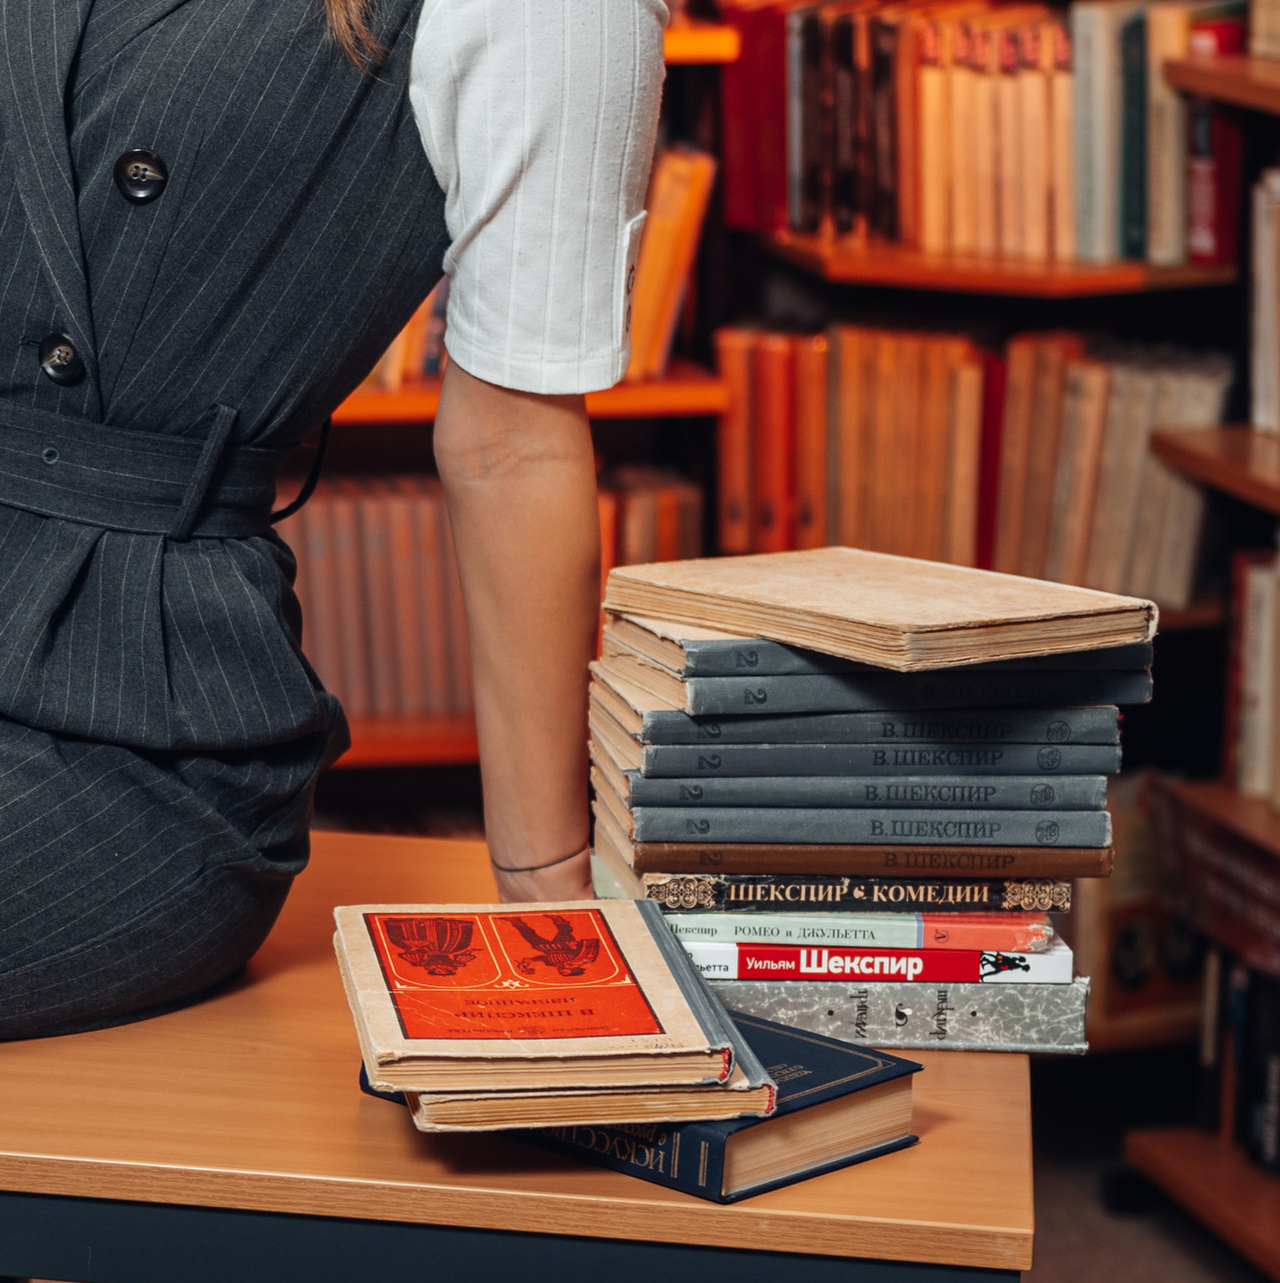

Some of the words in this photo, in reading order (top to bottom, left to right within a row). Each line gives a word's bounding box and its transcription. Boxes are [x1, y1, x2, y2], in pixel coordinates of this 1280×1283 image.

[744, 687, 768, 705] 2
[698, 754, 722, 770] 2
[680, 785, 704, 800] 2
[686, 819, 710, 835] 2
[730, 884, 849, 902] ШЕКСПИР
[873, 885, 989, 905] КОМЕДИИ
[734, 925, 780, 937] РОМЕО
[785, 929, 793, 938] и
[797, 926, 876, 940] ДЖУЛЬЕТТА
[696, 964, 730, 972] ьетта
[746, 957, 796, 971] Уильям
[800, 949, 924, 981] Шекспир
[455, 1010, 572, 1018] ШЕКСПИР
